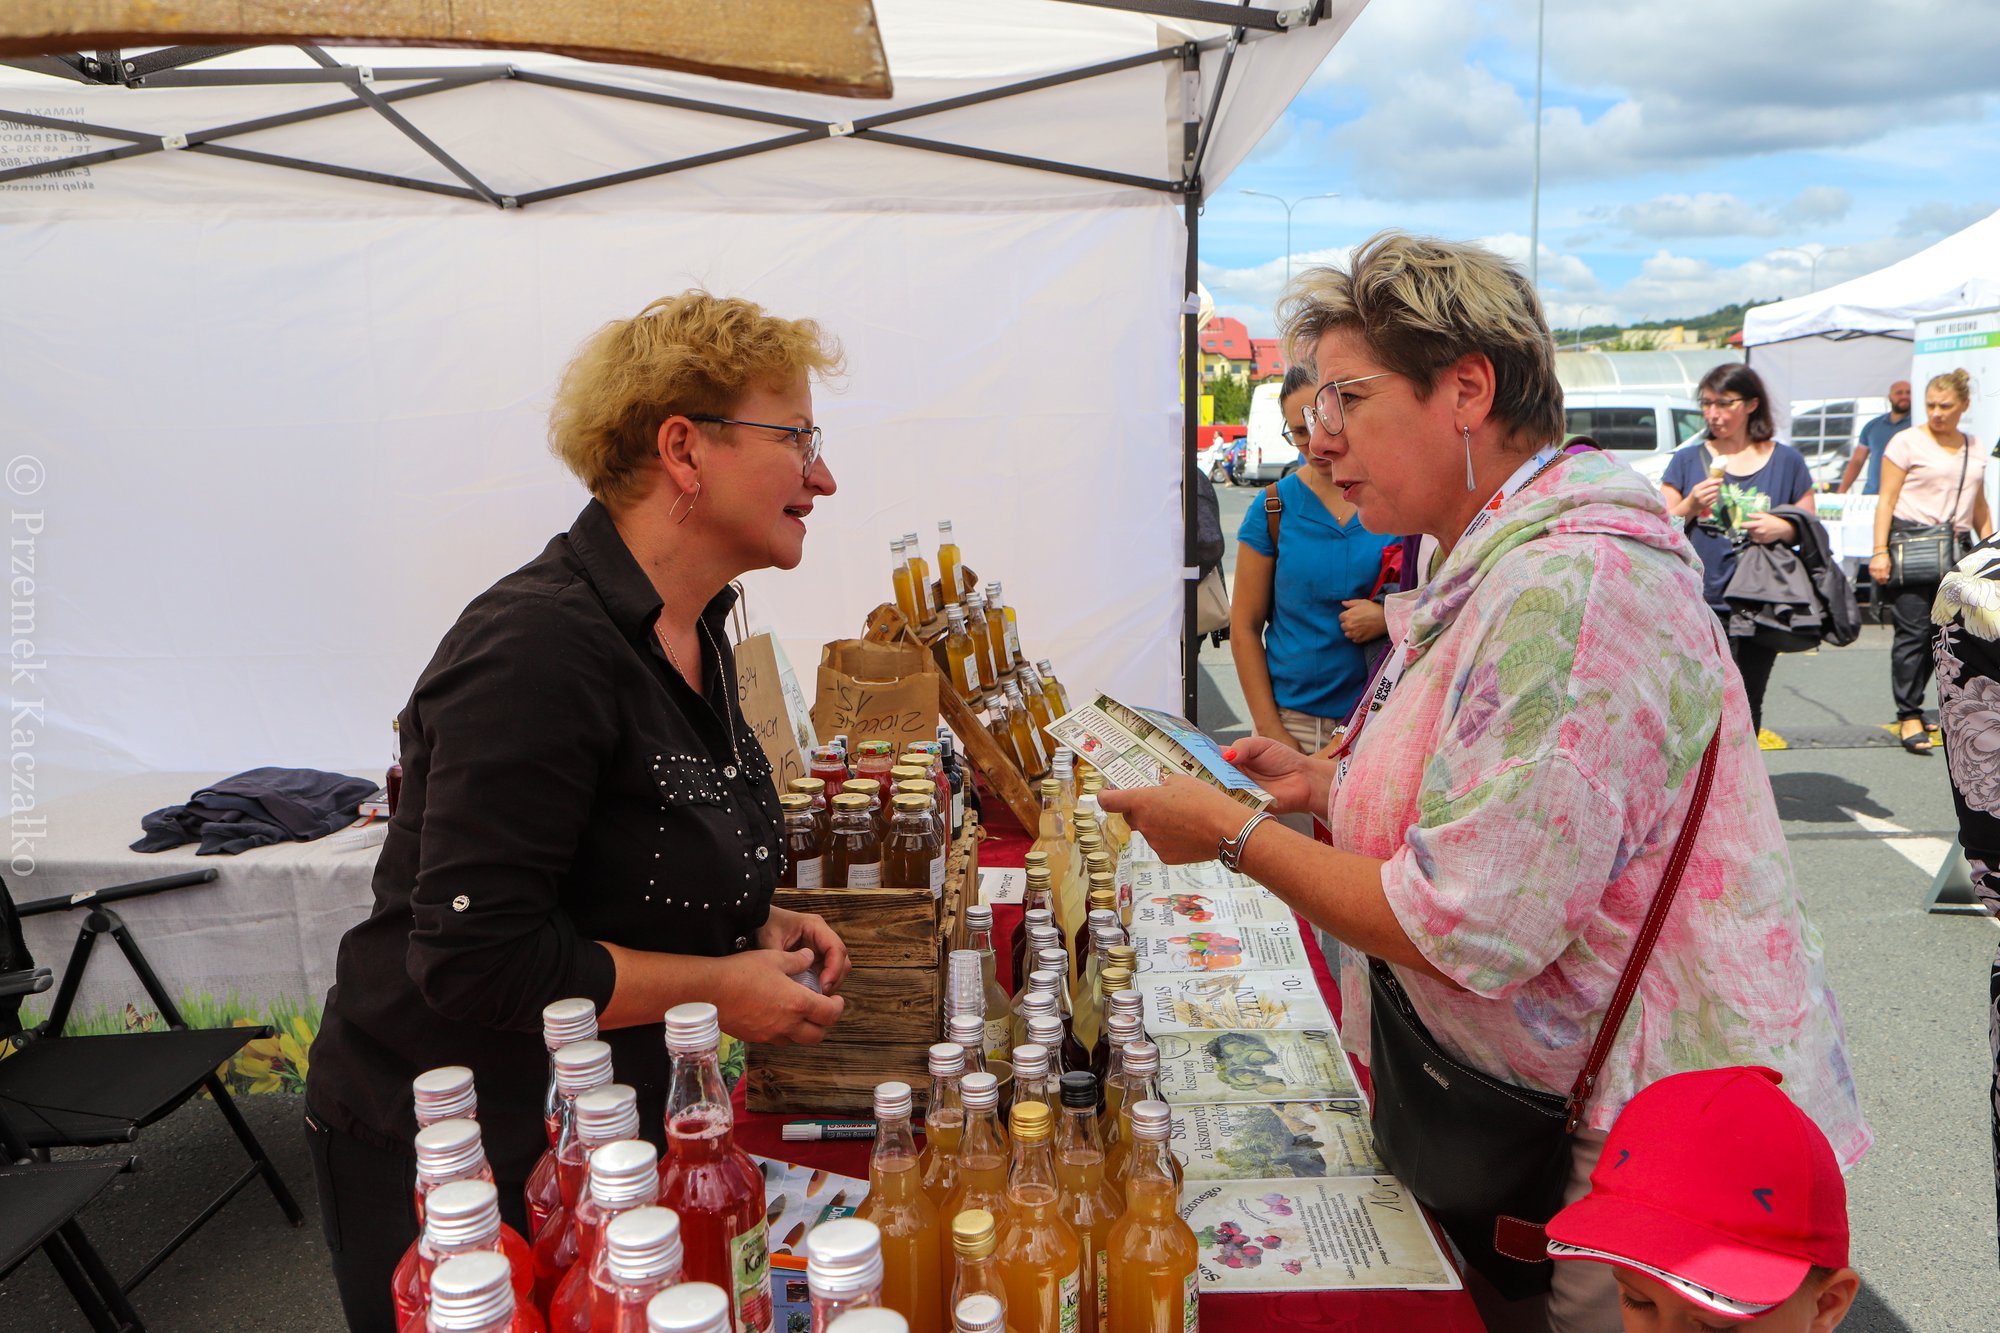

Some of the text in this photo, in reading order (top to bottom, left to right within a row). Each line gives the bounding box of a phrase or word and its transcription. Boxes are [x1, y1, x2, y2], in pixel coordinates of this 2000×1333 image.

[1374, 676, 1388, 700] DOLNY
[1136, 872, 1152, 887] Ocet
[1139, 907, 1155, 922] Ocet
[1153, 938, 1169, 955] Mocy
[1154, 986, 1177, 1024] ZAKWAS
[1196, 1043, 1216, 1074] kapusty
[1178, 1060, 1199, 1091] kiszonej
[1190, 1106, 1212, 1152] kiszonych
